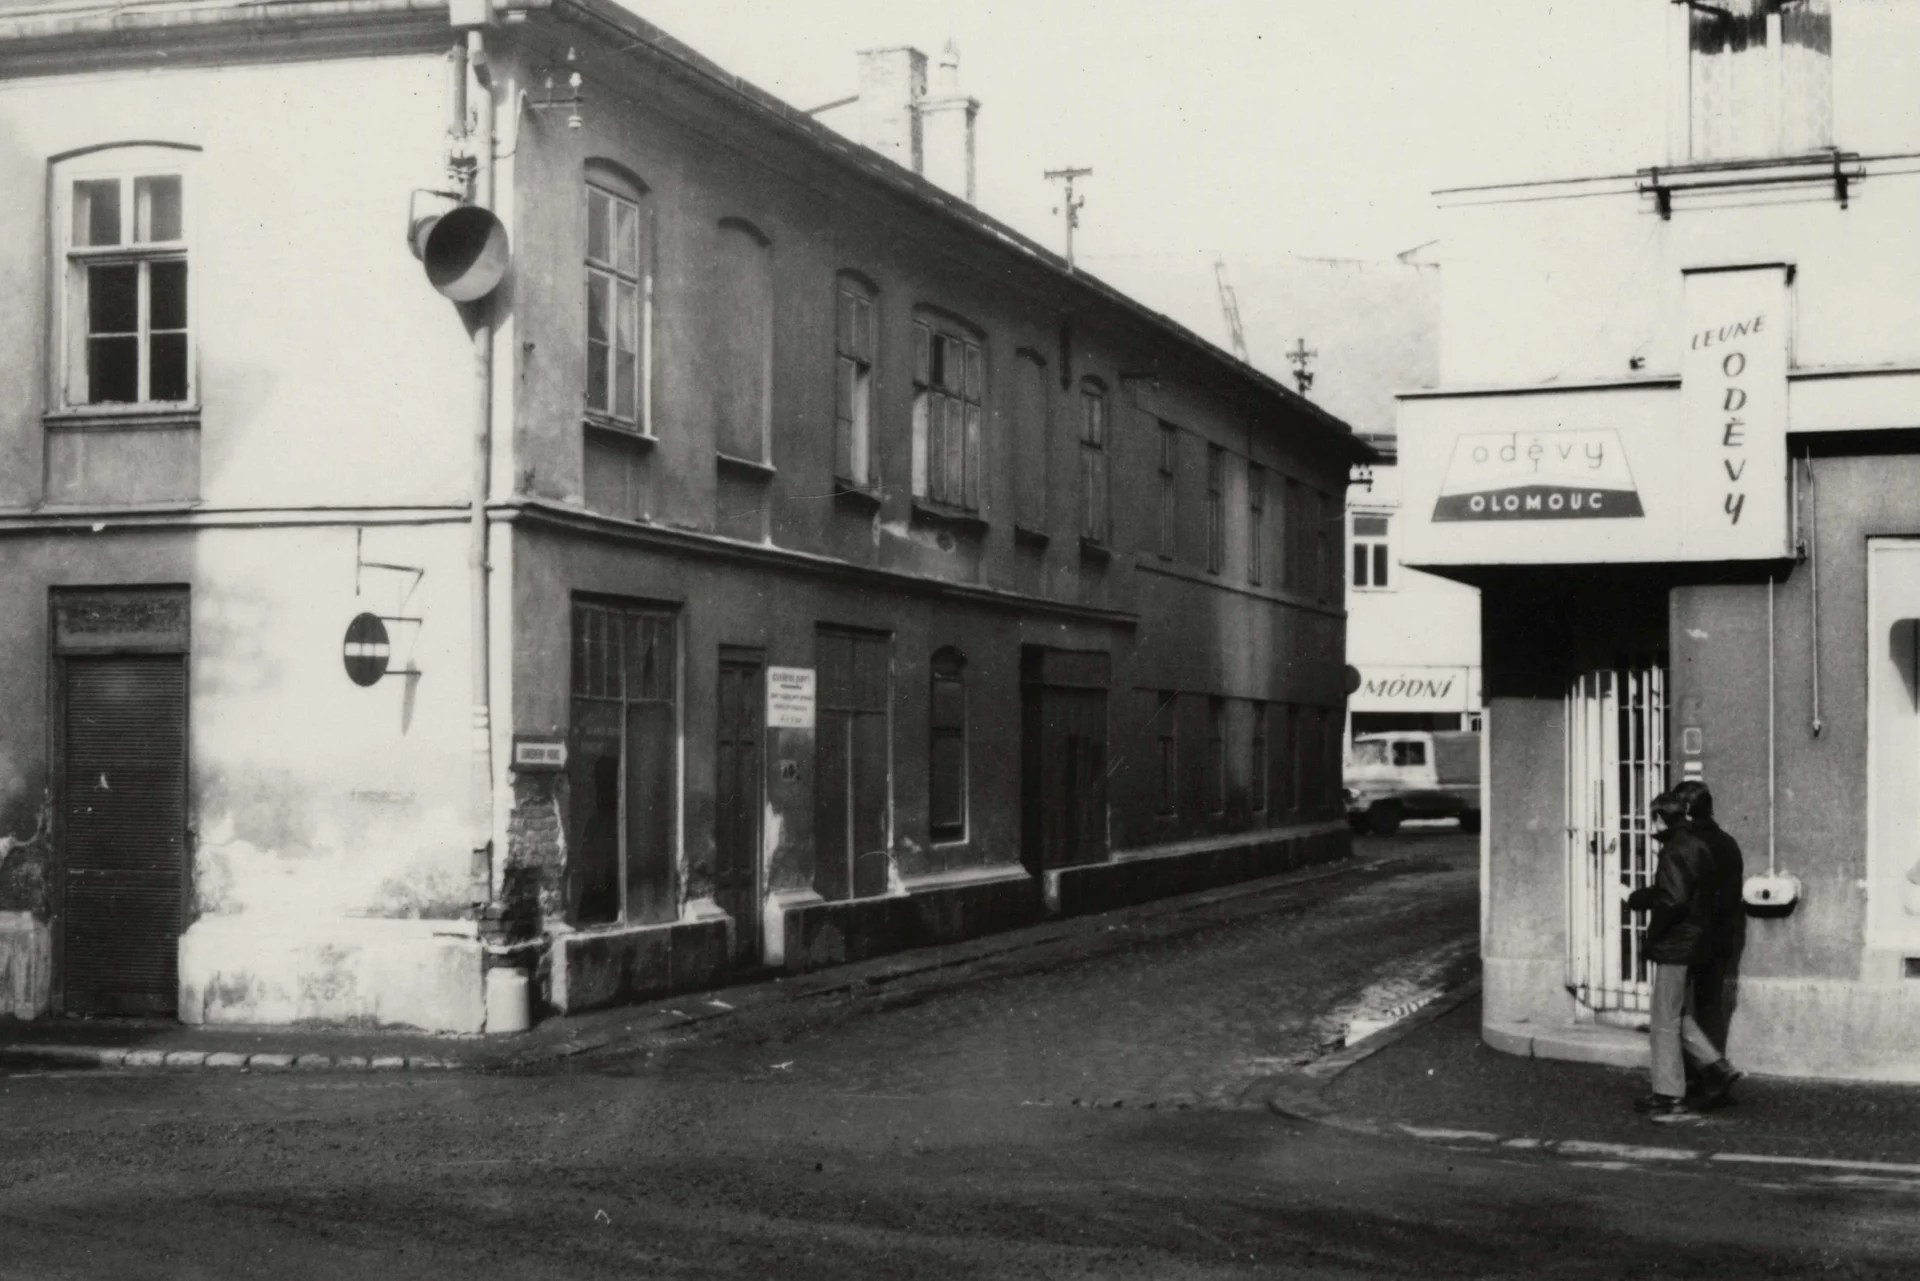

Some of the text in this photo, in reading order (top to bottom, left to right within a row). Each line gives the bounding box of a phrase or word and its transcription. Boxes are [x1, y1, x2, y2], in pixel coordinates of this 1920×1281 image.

[1472, 432, 1604, 472] oděvy
[1722, 351, 1747, 526] ODĚVY
[1470, 493, 1603, 512] OLOMOUC
